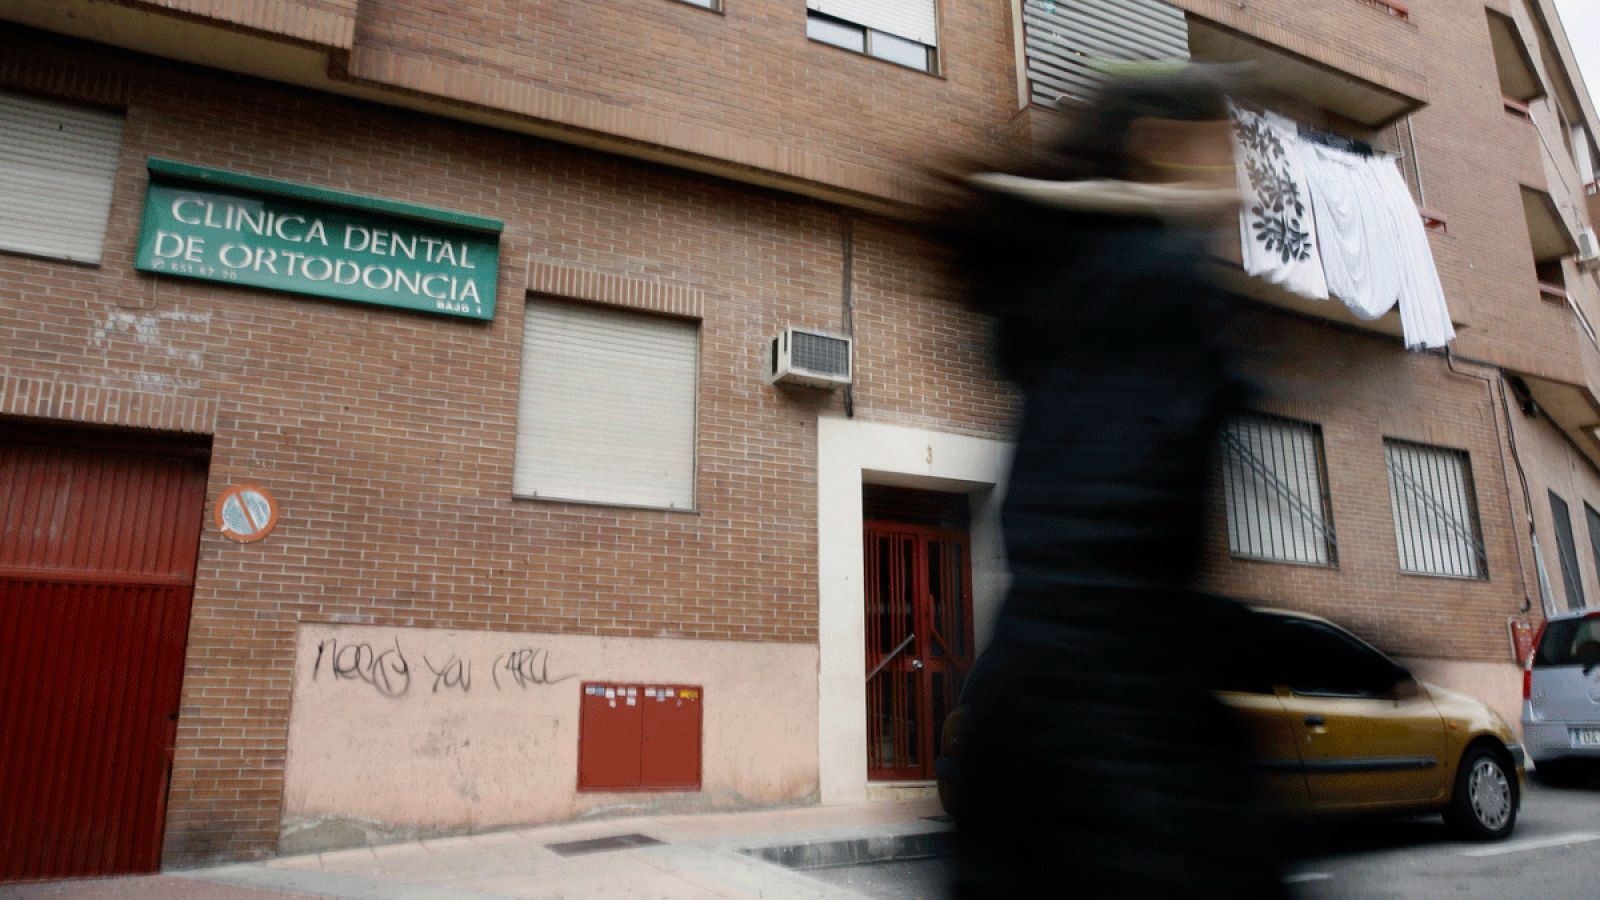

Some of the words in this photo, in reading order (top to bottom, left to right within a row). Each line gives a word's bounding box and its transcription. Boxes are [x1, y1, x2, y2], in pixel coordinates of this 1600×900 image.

[154, 231, 205, 263] DE
[219, 243, 481, 304] ORTODONCIA
[171, 198, 328, 246] CLINICA
[344, 224, 476, 269] DENTAL
